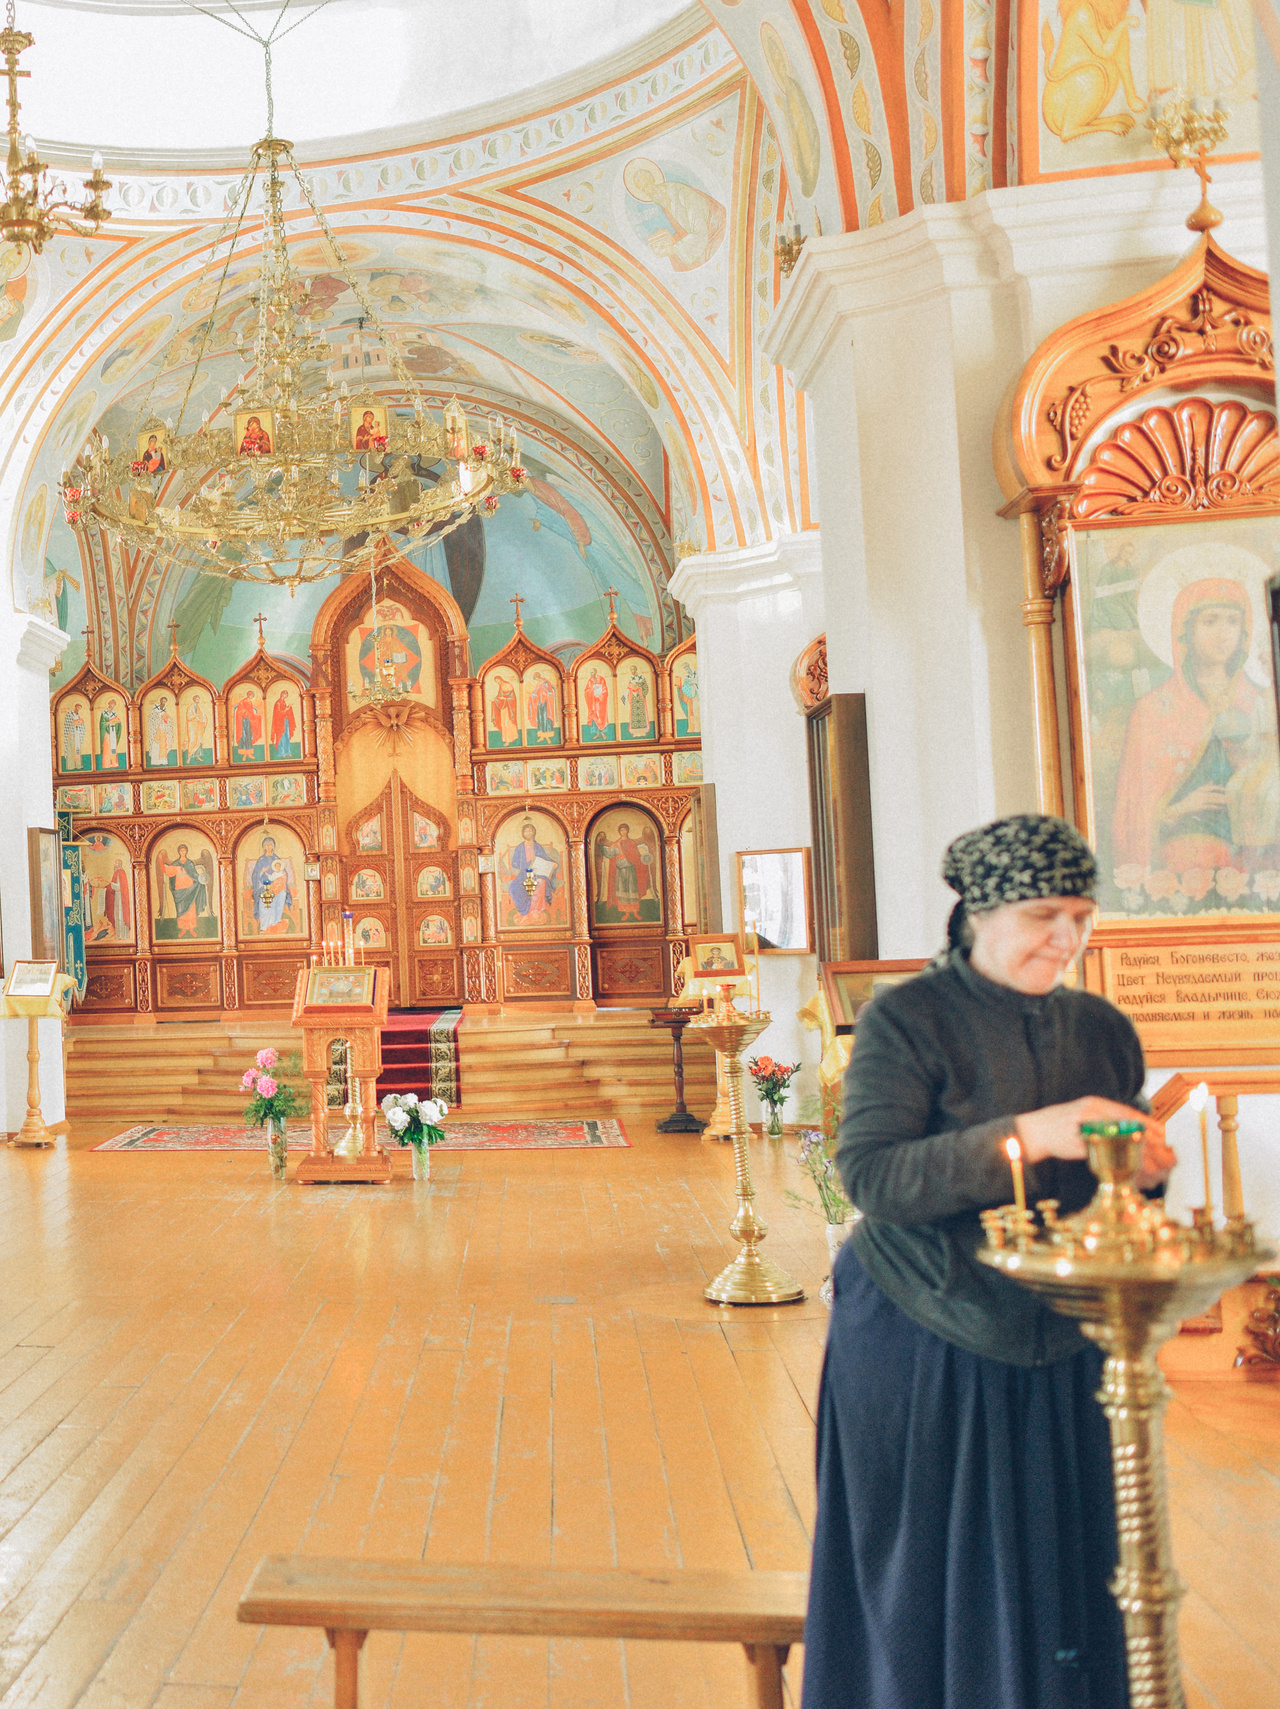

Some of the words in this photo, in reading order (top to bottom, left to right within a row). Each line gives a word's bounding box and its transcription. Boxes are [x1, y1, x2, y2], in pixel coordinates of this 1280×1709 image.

[1116, 974, 1146, 987] Цвет
[1156, 971, 1241, 987] Неувядаемый
[1117, 992, 1166, 1008] радуйся
[1127, 1011, 1194, 1023] полняемся
[1202, 1010, 1210, 1020] и
[1218, 1009, 1253, 1020] жизнь
